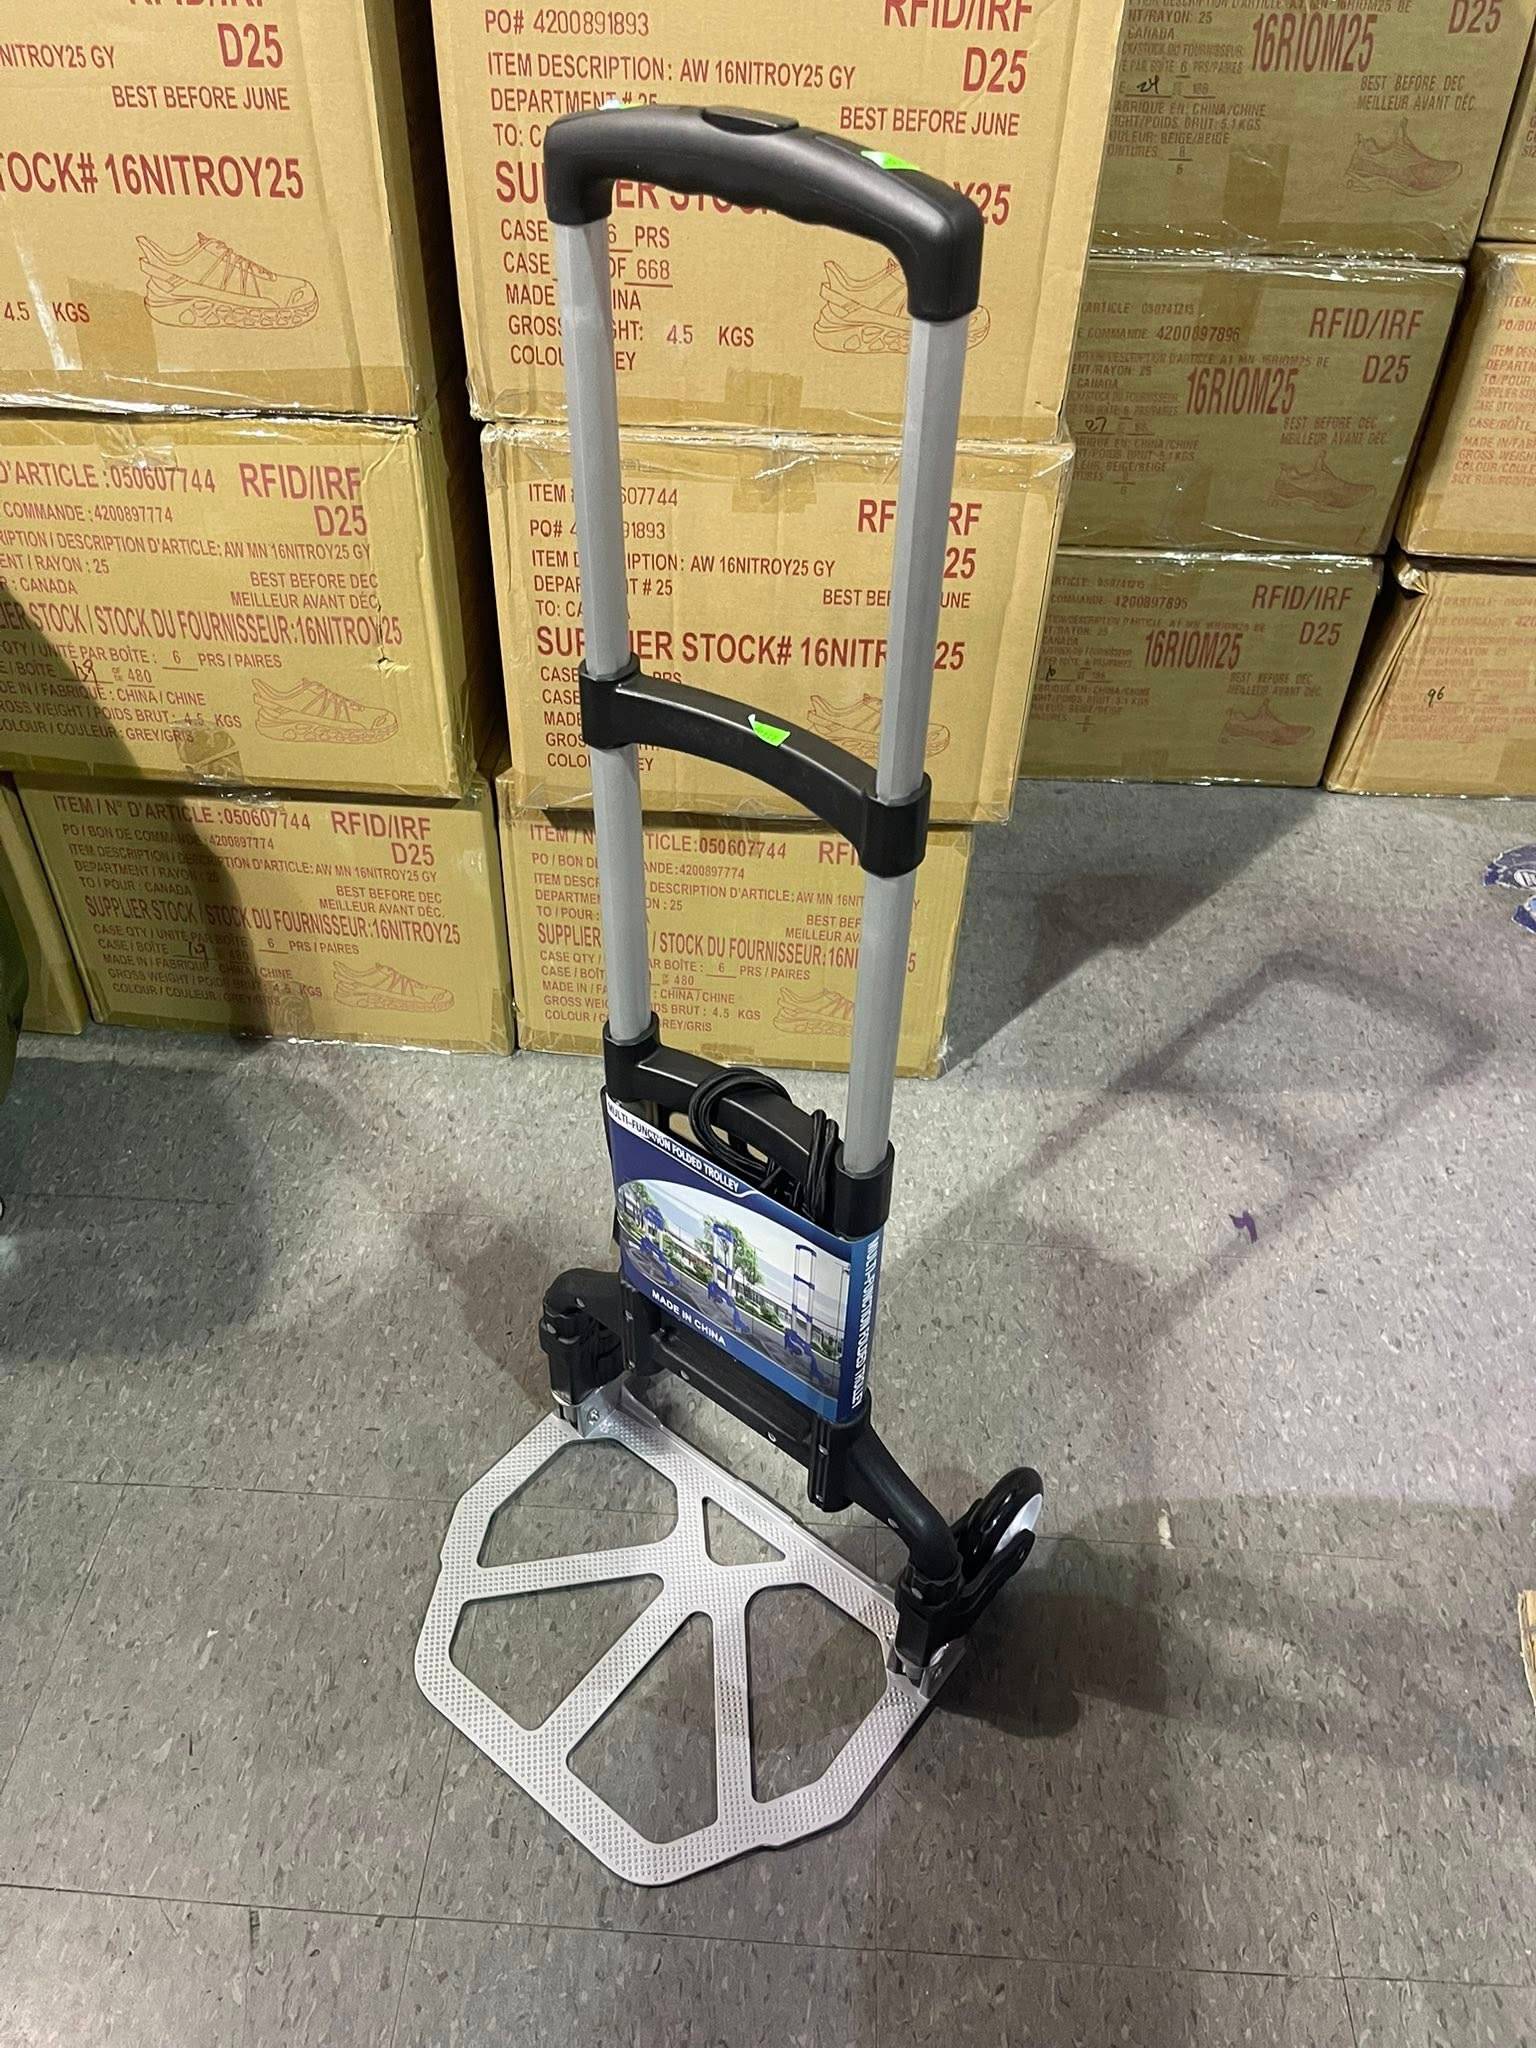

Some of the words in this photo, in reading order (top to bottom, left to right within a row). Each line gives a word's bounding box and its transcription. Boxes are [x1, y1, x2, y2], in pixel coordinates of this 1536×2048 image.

[485, 9, 524, 35] PO#
[534, 9, 649, 36] 4200891893
[1448, 0, 1501, 34] D25
[217, 23, 284, 69] D25
[1252, 13, 1378, 73] 16RIOM25
[0, 44, 87, 69] NITROY25
[91, 45, 115, 69] GY
[487, 51, 532, 78] ITEM
[680, 59, 709, 84] AW
[715, 60, 823, 88] 16NITROY25
[829, 64, 856, 90] GY
[962, 47, 1029, 94] D25
[1360, 75, 1387, 91] BEST
[1394, 75, 1437, 91] BEFORE
[111, 86, 158, 109] BEST
[163, 86, 239, 110] BEFORE
[242, 88, 291, 110] JUNE
[840, 106, 888, 131] BEST
[893, 108, 967, 134] BEFORE
[971, 111, 1020, 137] JUNE
[493, 123, 523, 147] TO:
[104, 154, 304, 200] 16NITROY25
[501, 218, 549, 242] CASE
[635, 225, 670, 248] PRS
[503, 251, 551, 275] CASE
[637, 259, 670, 280] 668
[506, 283, 556, 306] MADE
[4, 302, 30, 322] 4.5
[53, 302, 91, 324] KGS
[1308, 308, 1424, 340] RFID/IRF
[666, 325, 693, 345] 4.5
[718, 326, 754, 347] KGS
[1361, 354, 1411, 384] D25
[1187, 366, 1299, 415] 16RIOM25
[239, 463, 361, 500] RFID/IRF
[529, 483, 566, 503] ITEM
[3, 502, 85, 522] COMMANDE
[314, 505, 368, 537] D25
[529, 519, 562, 538] PO#
[57, 532, 147, 552] DESCRIPTION
[224, 541, 244, 558] AW
[249, 543, 268, 559] MN
[271, 543, 350, 560] 16NITROY25
[353, 543, 371, 561] GY
[35, 555, 83, 573] RAYON
[93, 558, 109, 574] 25
[532, 549, 569, 568] ITEM
[690, 555, 715, 573] AW
[719, 556, 809, 577] 16NITROY25
[813, 560, 836, 579] GY
[20, 576, 79, 595] CANADA
[250, 571, 286, 588] BEST
[290, 572, 347, 589] BEFORE
[350, 573, 379, 589] DEC
[656, 579, 673, 596] 25
[230, 591, 300, 608] MEILLEUR
[303, 594, 346, 609] AVANT
[535, 599, 561, 617] TO:
[823, 589, 863, 606] BEST
[1252, 584, 1353, 611] RFID/IRF
[29, 602, 88, 634] STOCK
[94, 605, 153, 638] STOCK
[151, 609, 176, 639] DU
[1299, 621, 1343, 646] D25
[80, 645, 108, 661] PAR
[198, 653, 225, 668] PRS
[235, 654, 283, 669] PAIRES
[682, 631, 792, 666] STOCK#
[1144, 629, 1243, 670] 16RIOM25
[128, 667, 153, 684] 480
[540, 666, 578, 683] CASE
[117, 688, 159, 704] CHINA
[166, 691, 207, 706] CHINE
[542, 688, 580, 705] CASE
[35, 702, 84, 718] WEIGHT
[94, 705, 133, 721] POIDS
[214, 713, 242, 729] KGS
[57, 723, 118, 739] COULEUR
[53, 795, 95, 815] ITEM
[331, 810, 432, 841] RFID/IRF
[530, 823, 568, 843] ITEM
[391, 842, 435, 867] D25
[531, 852, 549, 865] PO
[558, 854, 583, 867] BON
[315, 863, 332, 875] AW
[335, 865, 351, 877] MN
[355, 866, 419, 882] 16NITROY25
[422, 870, 437, 883] GY
[336, 885, 366, 898] BEST
[369, 887, 418, 903] BEFORE
[418, 891, 442, 904] DEC
[534, 872, 561, 886] ITEM
[650, 881, 727, 898] DESCRIPTION
[797, 891, 814, 904] AW
[817, 893, 833, 905] MN
[85, 895, 151, 920] SUPPLIER
[151, 900, 197, 924] STOCK
[205, 903, 251, 929] STOCK
[251, 908, 273, 930] DU
[319, 898, 377, 914] MEILLEUR
[379, 903, 415, 917] AVANT
[536, 905, 551, 918] TO
[561, 907, 593, 921] POUR
[670, 899, 683, 912] 25
[806, 914, 837, 927] BEST
[538, 922, 602, 948] SUPPLIER
[659, 932, 704, 956] STOCK
[707, 935, 727, 958] DU
[785, 927, 842, 943] MEILLEUR
[289, 940, 312, 953] PRS
[320, 941, 360, 955] PAIRES
[260, 966, 293, 980] CHINE
[540, 950, 570, 962] CASE
[573, 953, 595, 964] QTY
[739, 966, 762, 977] PRS
[771, 967, 811, 981] PAIRES
[541, 965, 571, 977] CASE
[674, 975, 694, 986] 480
[542, 980, 574, 992] MADE
[576, 982, 588, 993] IN
[660, 989, 694, 1001] CHINA
[702, 991, 735, 1004] CHINE
[544, 995, 582, 1007] GROSS
[738, 1009, 761, 1021] KGS
[545, 1009, 590, 1023] COLOUR
[671, 1142, 703, 1171] FOLDED
[703, 1163, 740, 1193] TROLLEY
[651, 1288, 680, 1317] MADE
[682, 1309, 693, 1324] IN
[693, 1316, 727, 1347] CHINA
